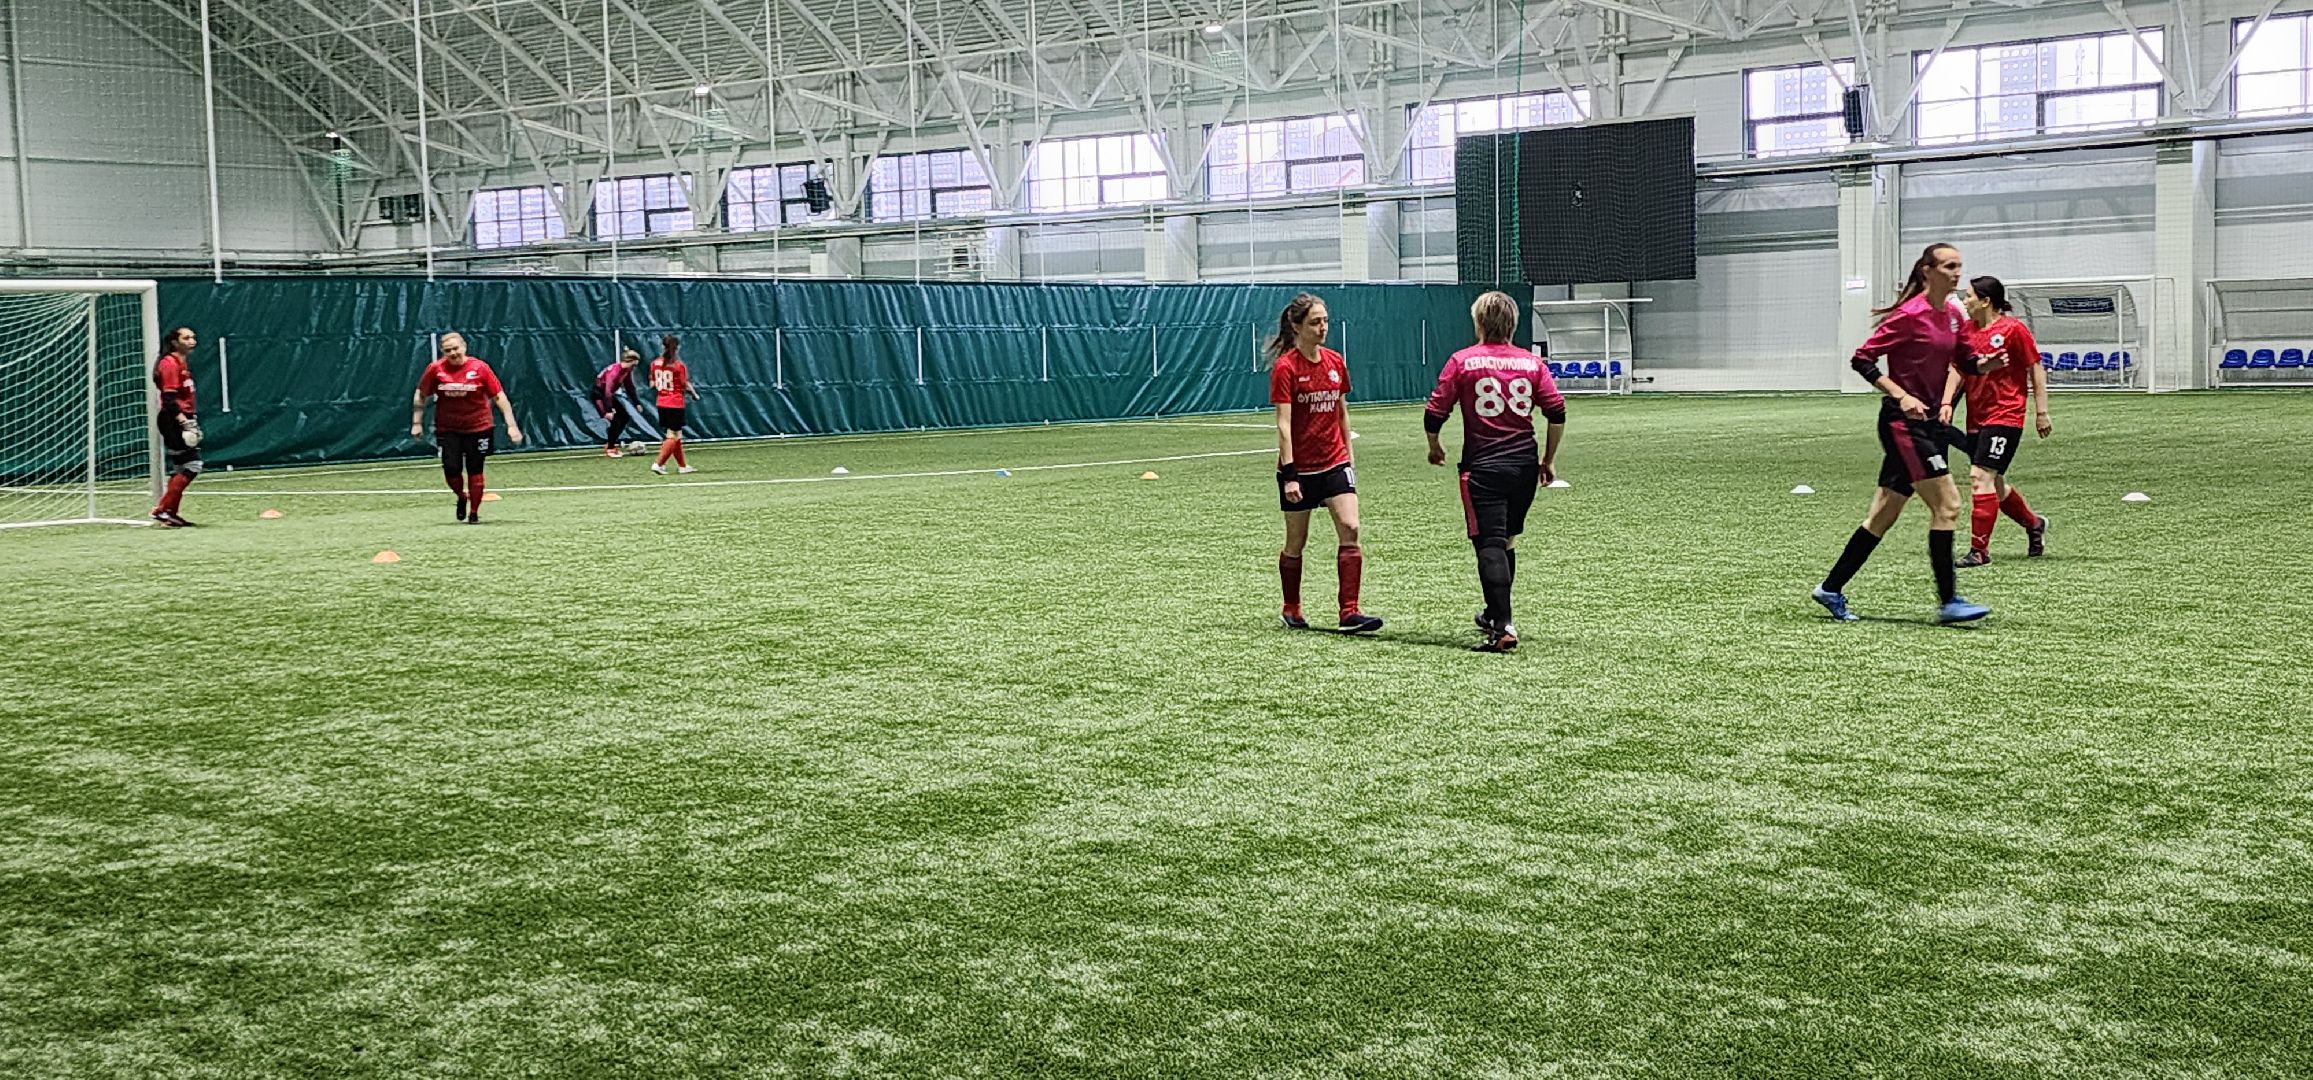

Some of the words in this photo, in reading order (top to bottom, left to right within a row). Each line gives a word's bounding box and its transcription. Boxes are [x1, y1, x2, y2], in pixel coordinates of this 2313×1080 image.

[655, 369, 675, 391] 88
[1475, 377, 1532, 417] 88
[1989, 436, 2007, 455] 13
